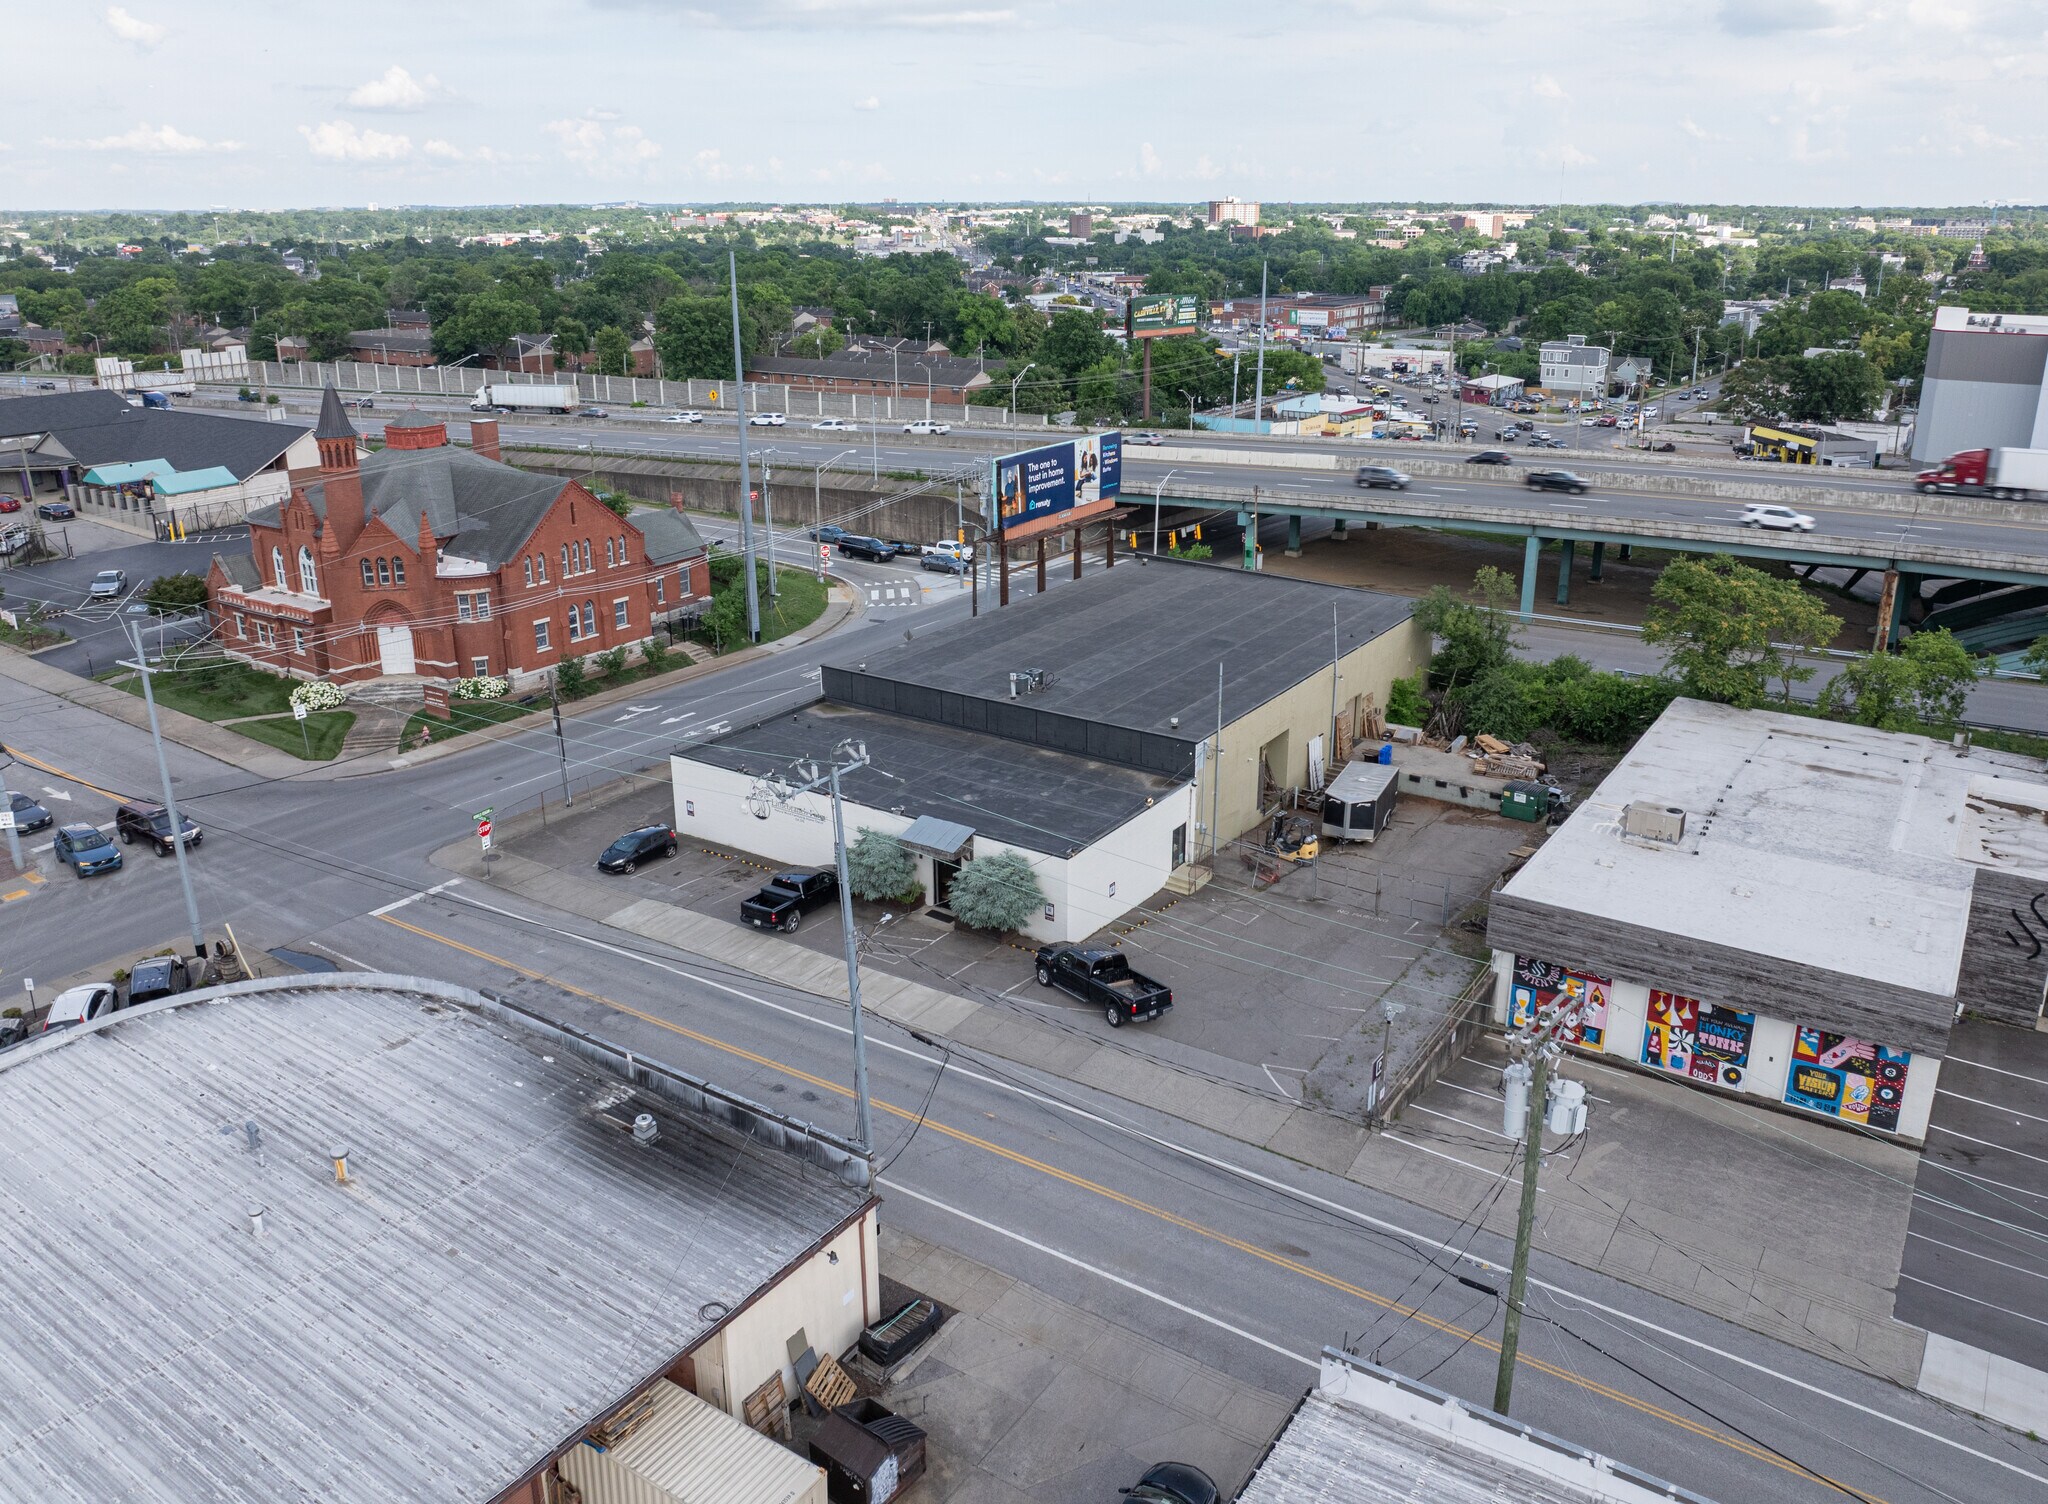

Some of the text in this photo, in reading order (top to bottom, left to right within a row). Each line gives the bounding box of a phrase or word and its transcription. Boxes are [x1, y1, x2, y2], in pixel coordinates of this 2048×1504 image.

[1028, 459, 1057, 472] The one to
[1028, 468, 1064, 483] trust in home
[1028, 476, 1065, 493] improvement.
[479, 823, 491, 834] STOP
[1699, 1022, 1746, 1041] HONKY
[1699, 1032, 1744, 1054] TONK
[1693, 1069, 1714, 1081] ODDS
[1809, 1069, 1827, 1079] YOUR
[1798, 1073, 1836, 1096] VISION
